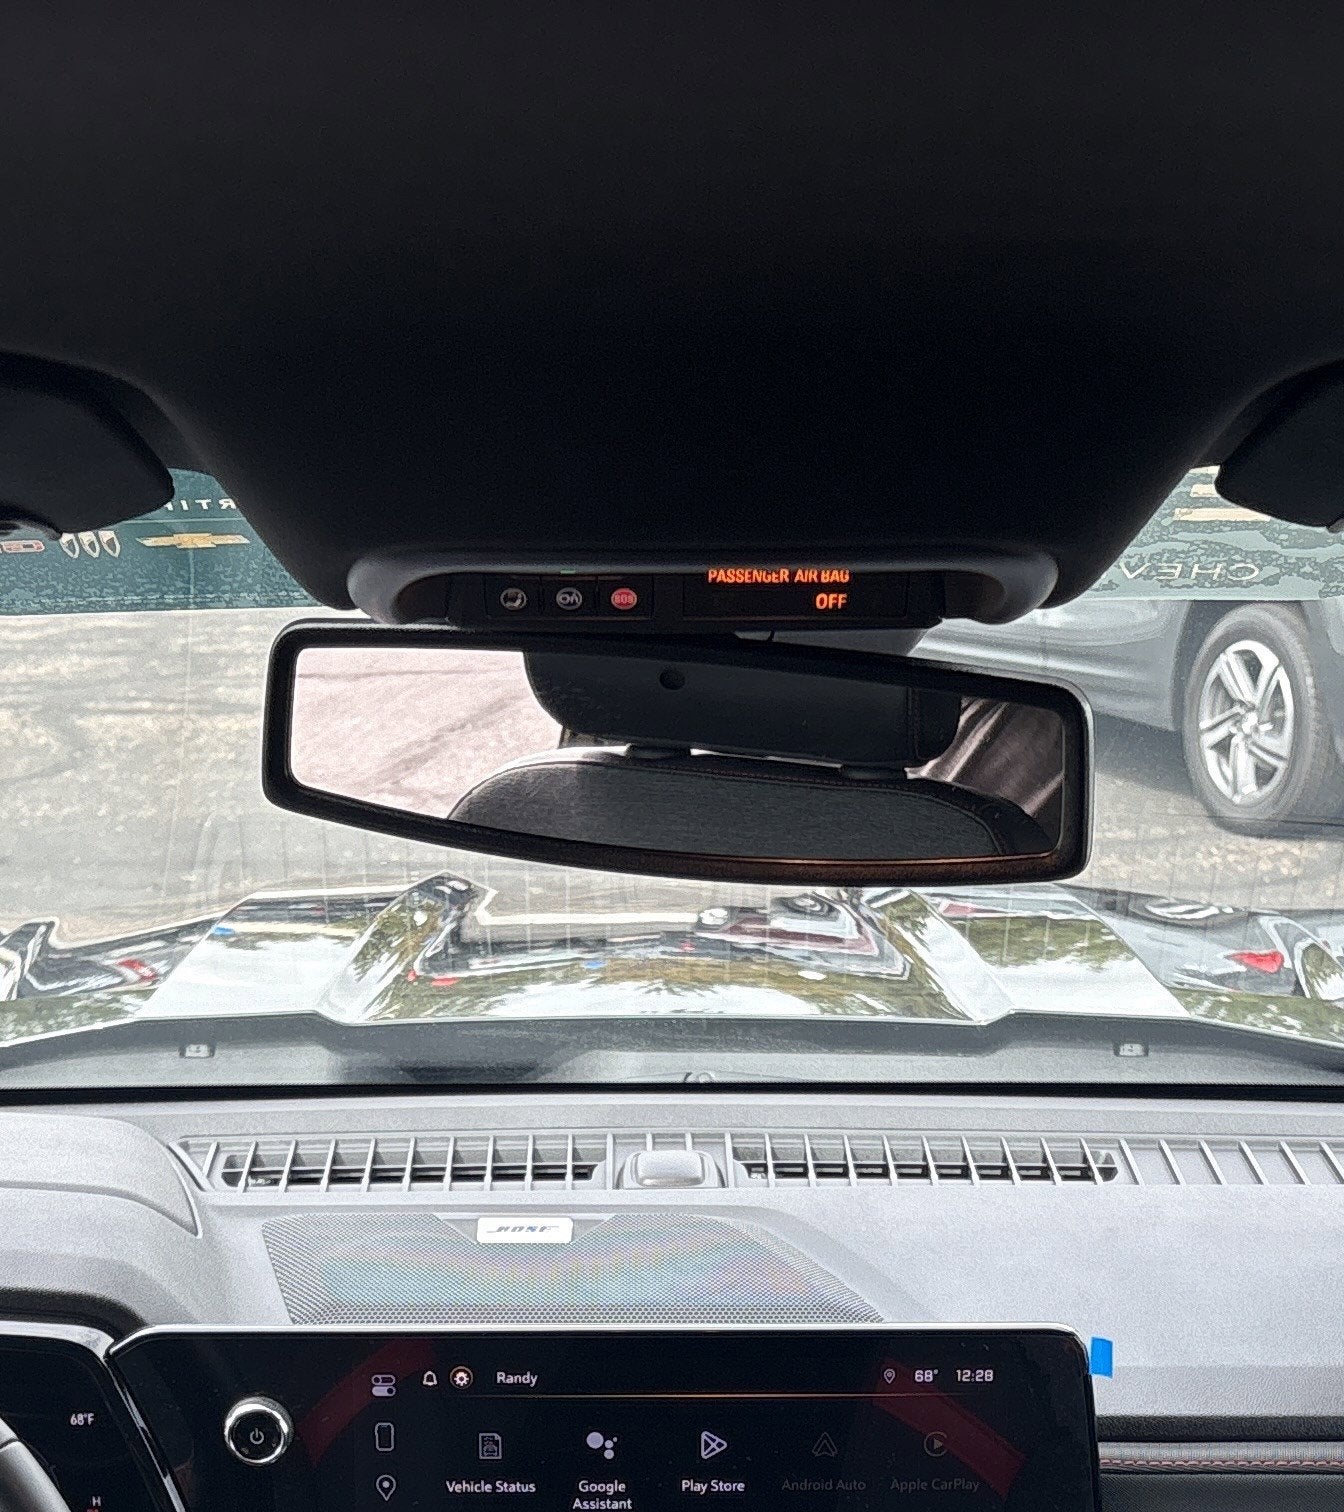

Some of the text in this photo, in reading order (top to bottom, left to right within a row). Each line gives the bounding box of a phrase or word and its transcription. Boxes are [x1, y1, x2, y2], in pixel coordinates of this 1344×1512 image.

[708, 569, 789, 583] PASSENGER
[794, 569, 817, 583] AIR
[816, 593, 847, 609] OFF
[496, 1371, 538, 1388] Randy
[956, 1369, 994, 1383] 12:28
[446, 1479, 536, 1493] Vehicle Status
[578, 1479, 626, 1497] Google
[681, 1479, 745, 1496] Play Store
[782, 1478, 866, 1491] Android Auto
[890, 1478, 979, 1494] Apple CarPlay
[573, 1497, 632, 1511] Assistant
